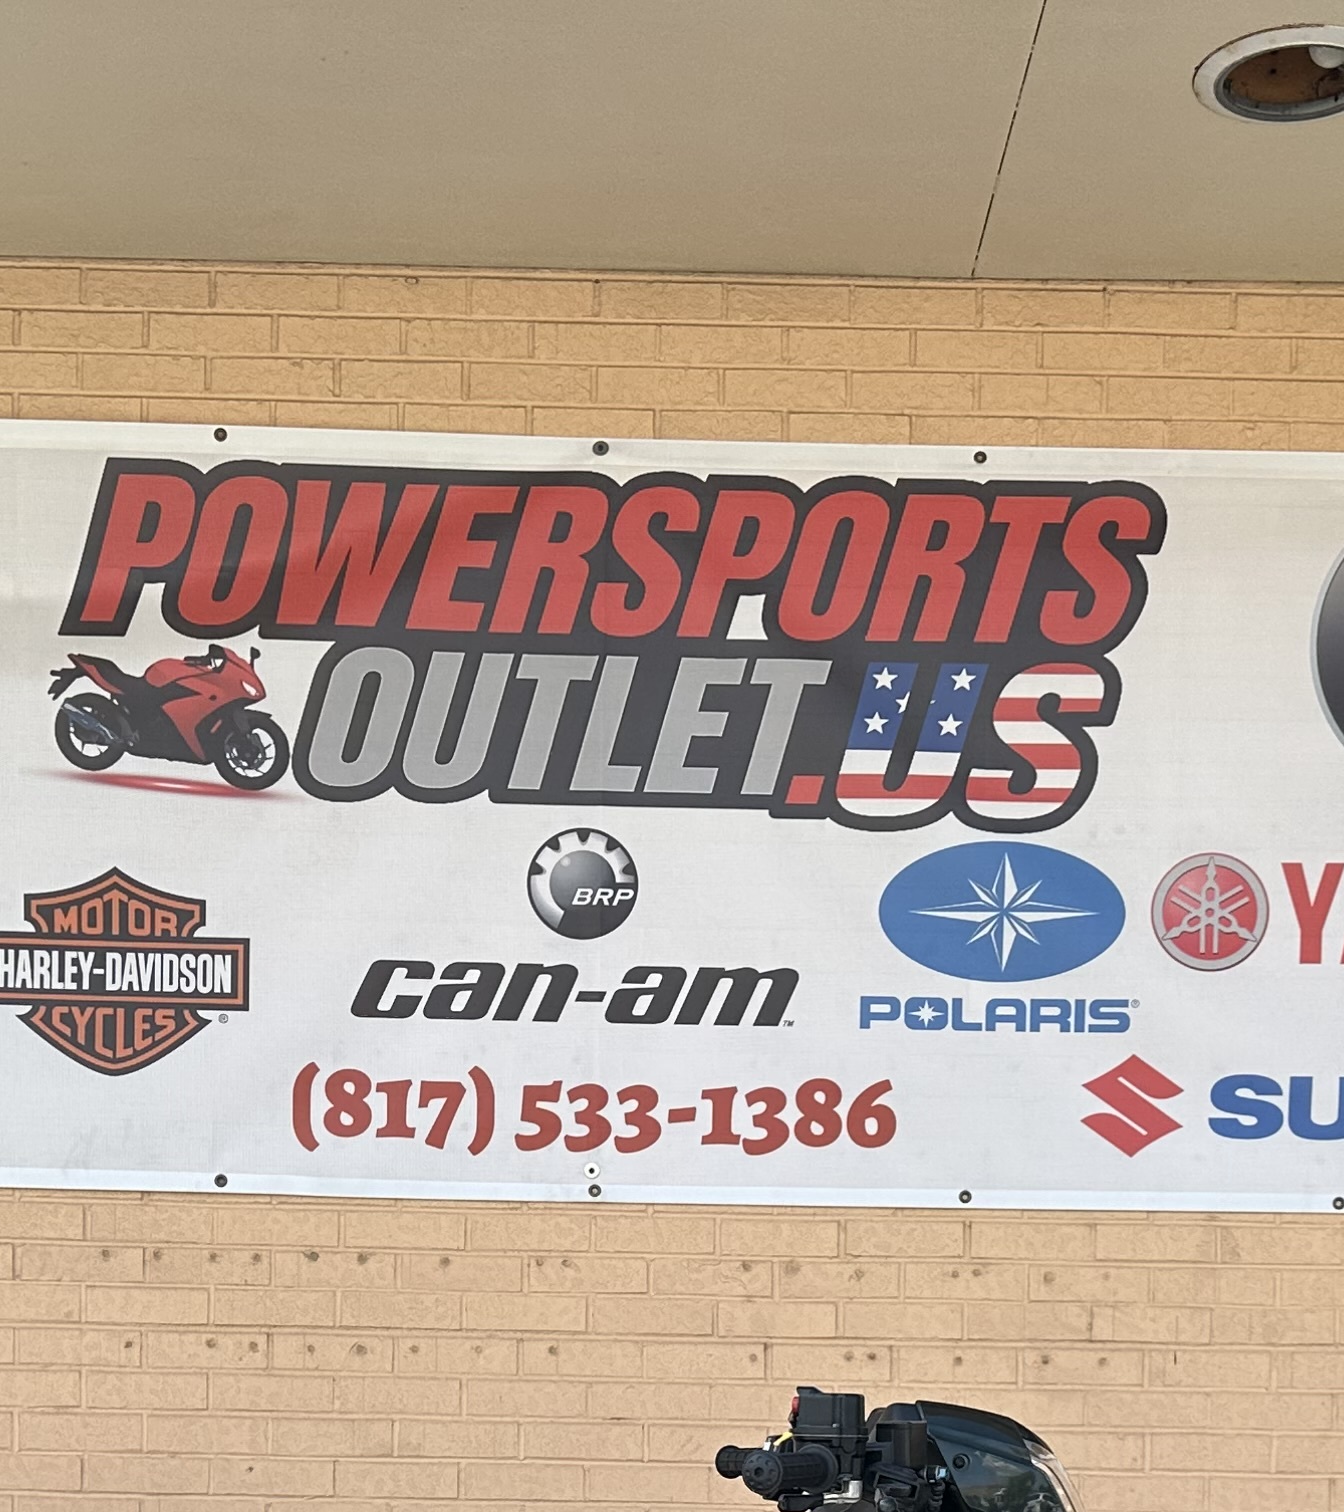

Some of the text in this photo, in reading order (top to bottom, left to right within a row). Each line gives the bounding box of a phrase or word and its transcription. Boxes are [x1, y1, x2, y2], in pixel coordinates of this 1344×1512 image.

[76, 470, 1154, 648] POWERSPORTS
[304, 644, 1119, 822] OUTLET.US
[53, 888, 178, 937] MOTOR
[570, 886, 635, 907] BRP
[349, 959, 800, 1027] can-am
[859, 995, 1131, 1034] POLARIS
[51, 1005, 176, 1059] CYCLES
[291, 1061, 898, 1156] (817) 533-1386
